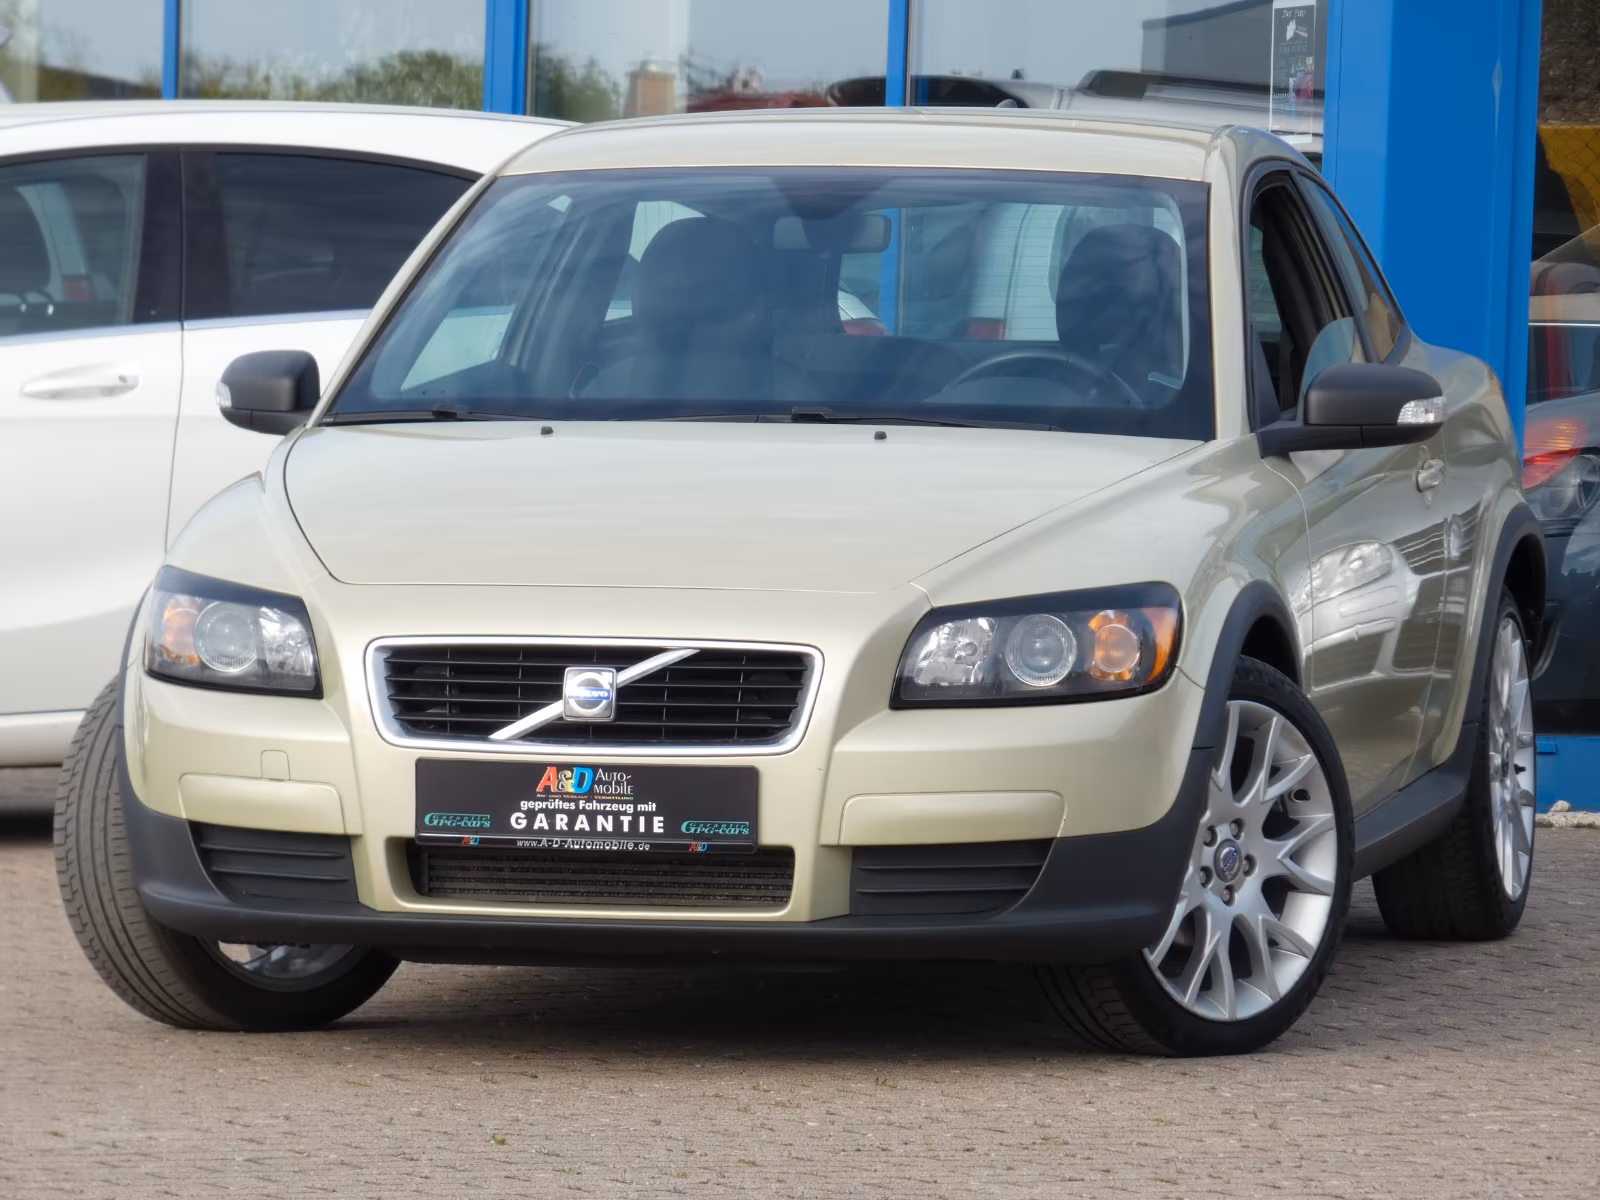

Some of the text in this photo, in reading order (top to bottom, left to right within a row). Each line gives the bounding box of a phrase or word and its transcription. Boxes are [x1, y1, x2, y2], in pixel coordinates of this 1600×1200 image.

[536, 766, 594, 794] A&D
[520, 798, 657, 813] geprüftes Fahrzeug mit
[510, 812, 665, 833] GARANTIE
[516, 838, 651, 851] www.A-D-Automobile.de
